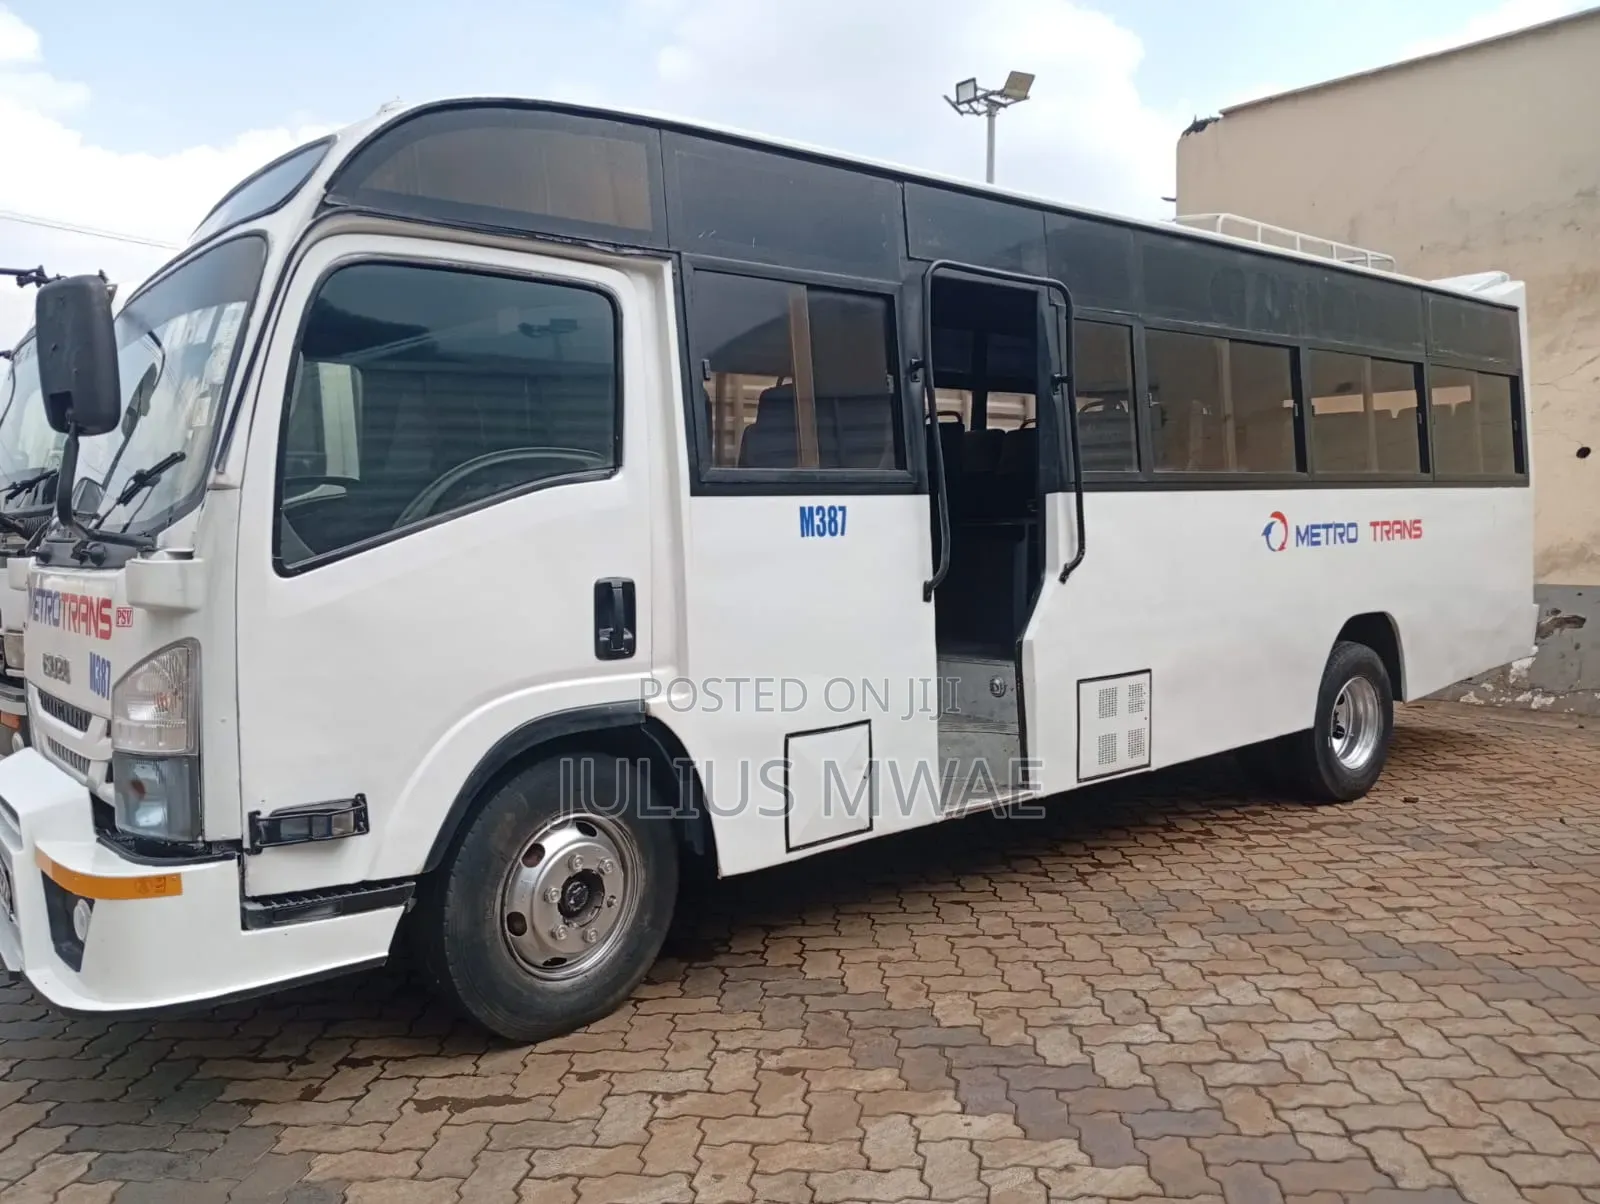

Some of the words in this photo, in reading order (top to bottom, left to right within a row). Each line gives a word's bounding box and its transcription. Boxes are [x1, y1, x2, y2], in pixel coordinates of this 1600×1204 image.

[799, 505, 847, 537] M387
[1295, 521, 1358, 547] METRO
[1369, 519, 1423, 542] TRANS
[116, 608, 133, 626] PSV
[89, 651, 111, 701] M387
